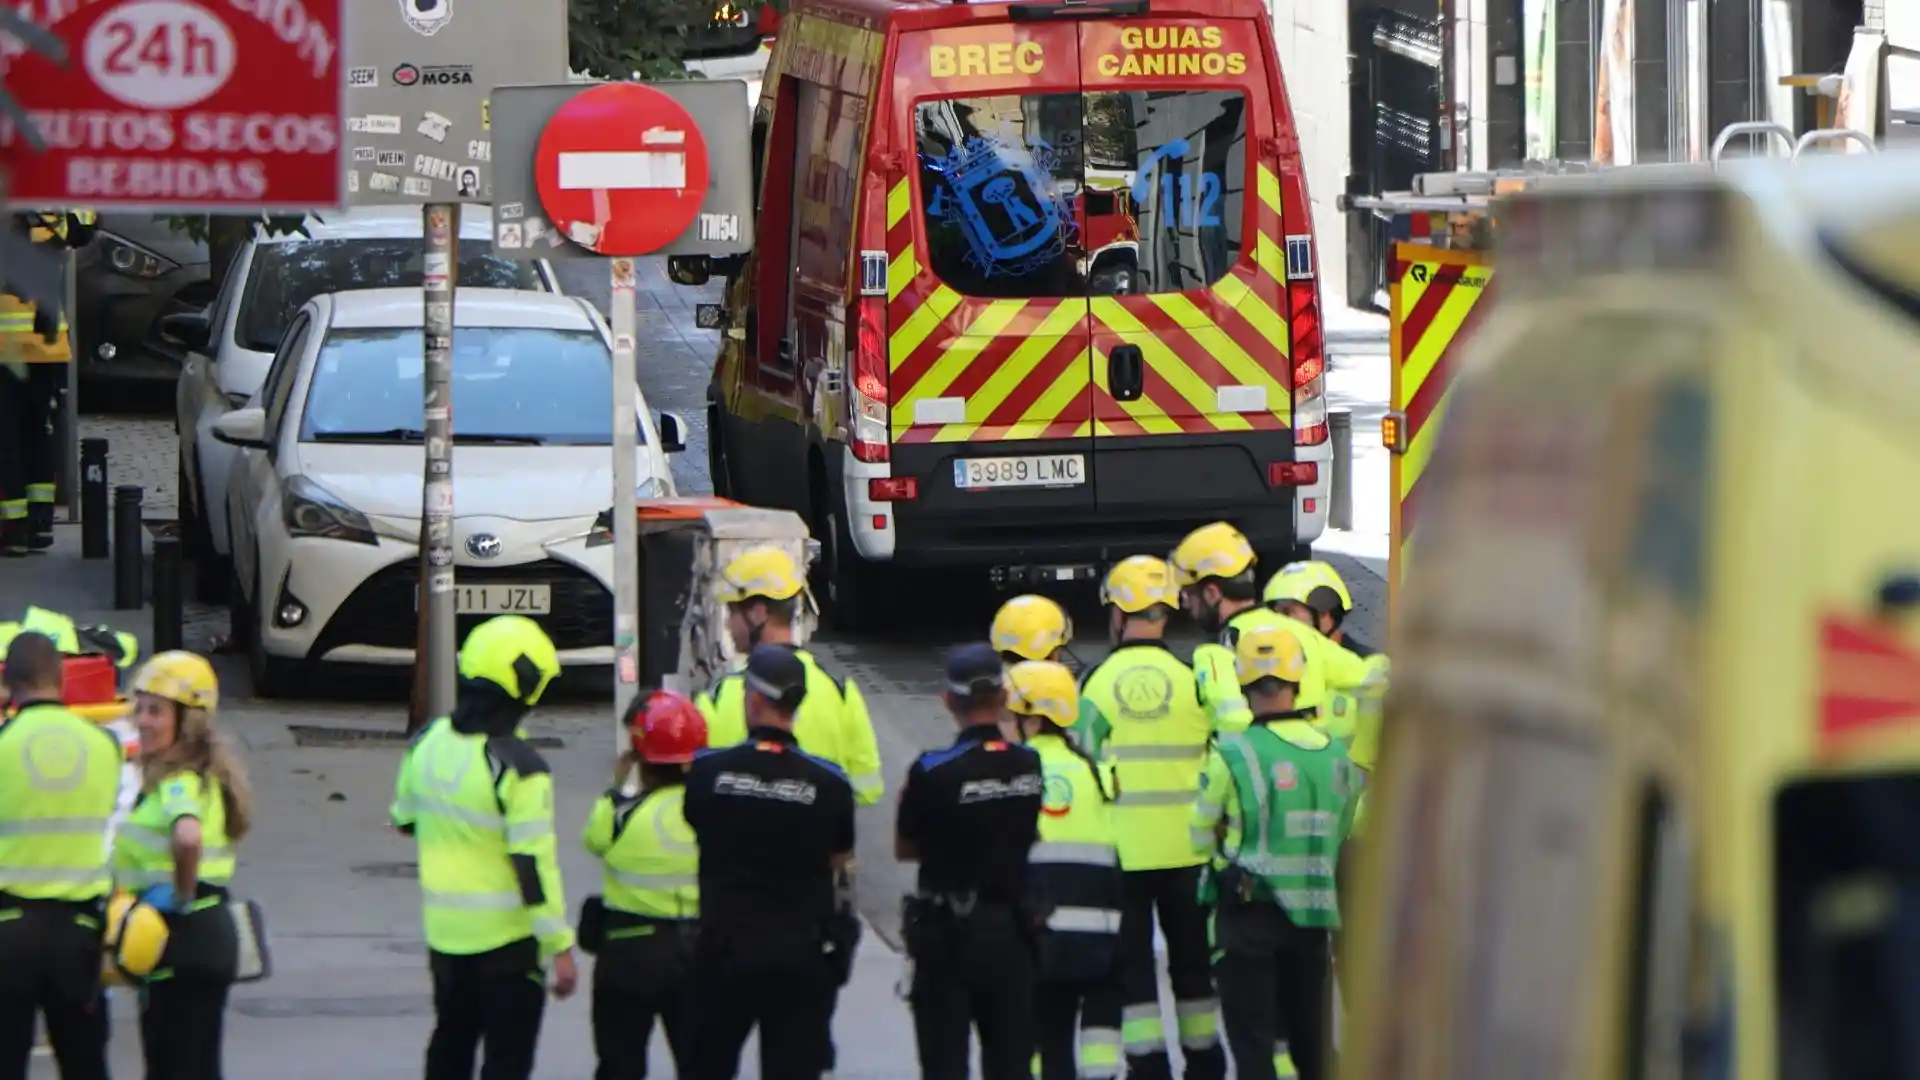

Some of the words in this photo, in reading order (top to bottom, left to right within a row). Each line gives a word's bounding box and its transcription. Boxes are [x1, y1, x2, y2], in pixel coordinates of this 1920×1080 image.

[104, 22, 217, 77] 24h
[1120, 26, 1222, 50] GUIAS
[929, 41, 1044, 78] BREC
[1097, 52, 1247, 77] CANINOS
[422, 72, 472, 85] MOSA
[186, 112, 335, 153] SECOS
[378, 152, 404, 164] WEIN
[66, 158, 266, 198] BEBIDAS
[1161, 172, 1222, 228] 112
[700, 214, 740, 241] TM54
[970, 461, 1028, 482] 3989
[1037, 458, 1079, 480] LMC
[500, 588, 541, 610] JZL
